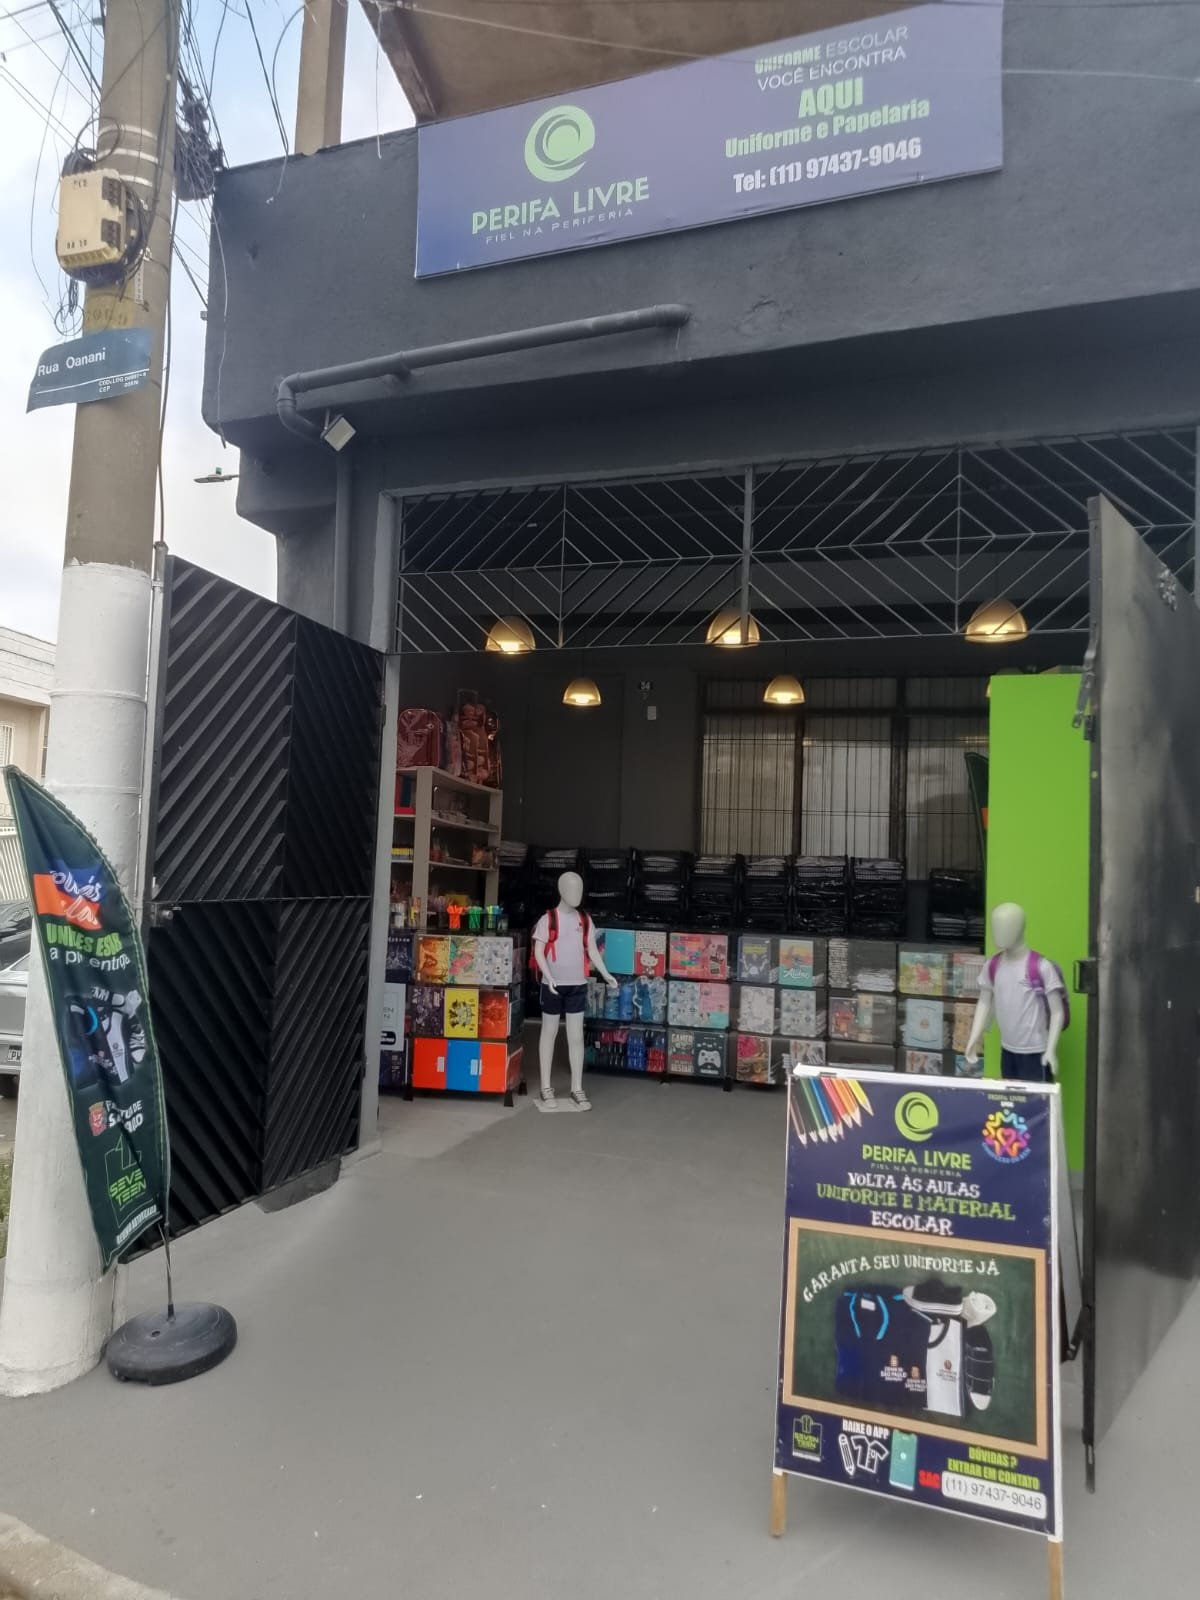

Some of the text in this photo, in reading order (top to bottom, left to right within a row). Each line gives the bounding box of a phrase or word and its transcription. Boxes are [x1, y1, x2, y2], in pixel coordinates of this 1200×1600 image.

[755, 26, 908, 74] UNIFORME ESCOLAR
[758, 46, 907, 91] VOCÊ ENCONTRA
[798, 77, 863, 118] AQUI
[725, 98, 930, 158] Uniforme e Papelaria
[733, 137, 921, 193] Tel: (11) 97437-9046
[472, 176, 650, 234] PERIFA LIVRE
[486, 208, 633, 245] FIEL NA PERIFERIA
[38, 347, 106, 376] Rua Oanani
[862, 1144, 917, 1165] PERIFA
[924, 1150, 972, 1170] LIVRE
[871, 1163, 889, 1171] FIEL
[110, 1168, 144, 1198] SEVE
[848, 1172, 980, 1199] VOLTA ÀS AULAS
[816, 1183, 1016, 1221] UNIFORME E MATERIAL
[871, 1210, 953, 1235] ESCOLAR
[803, 1254, 1000, 1302] GARANTA SEU UNIFORME JÁ
[842, 1418, 890, 1440] BAIXE O APP
[947, 1457, 1040, 1490] ENTRAR EM CONTATO
[968, 1446, 1009, 1467] DÚVIDAS
[945, 1476, 1042, 1510] (11) 97437-9046
